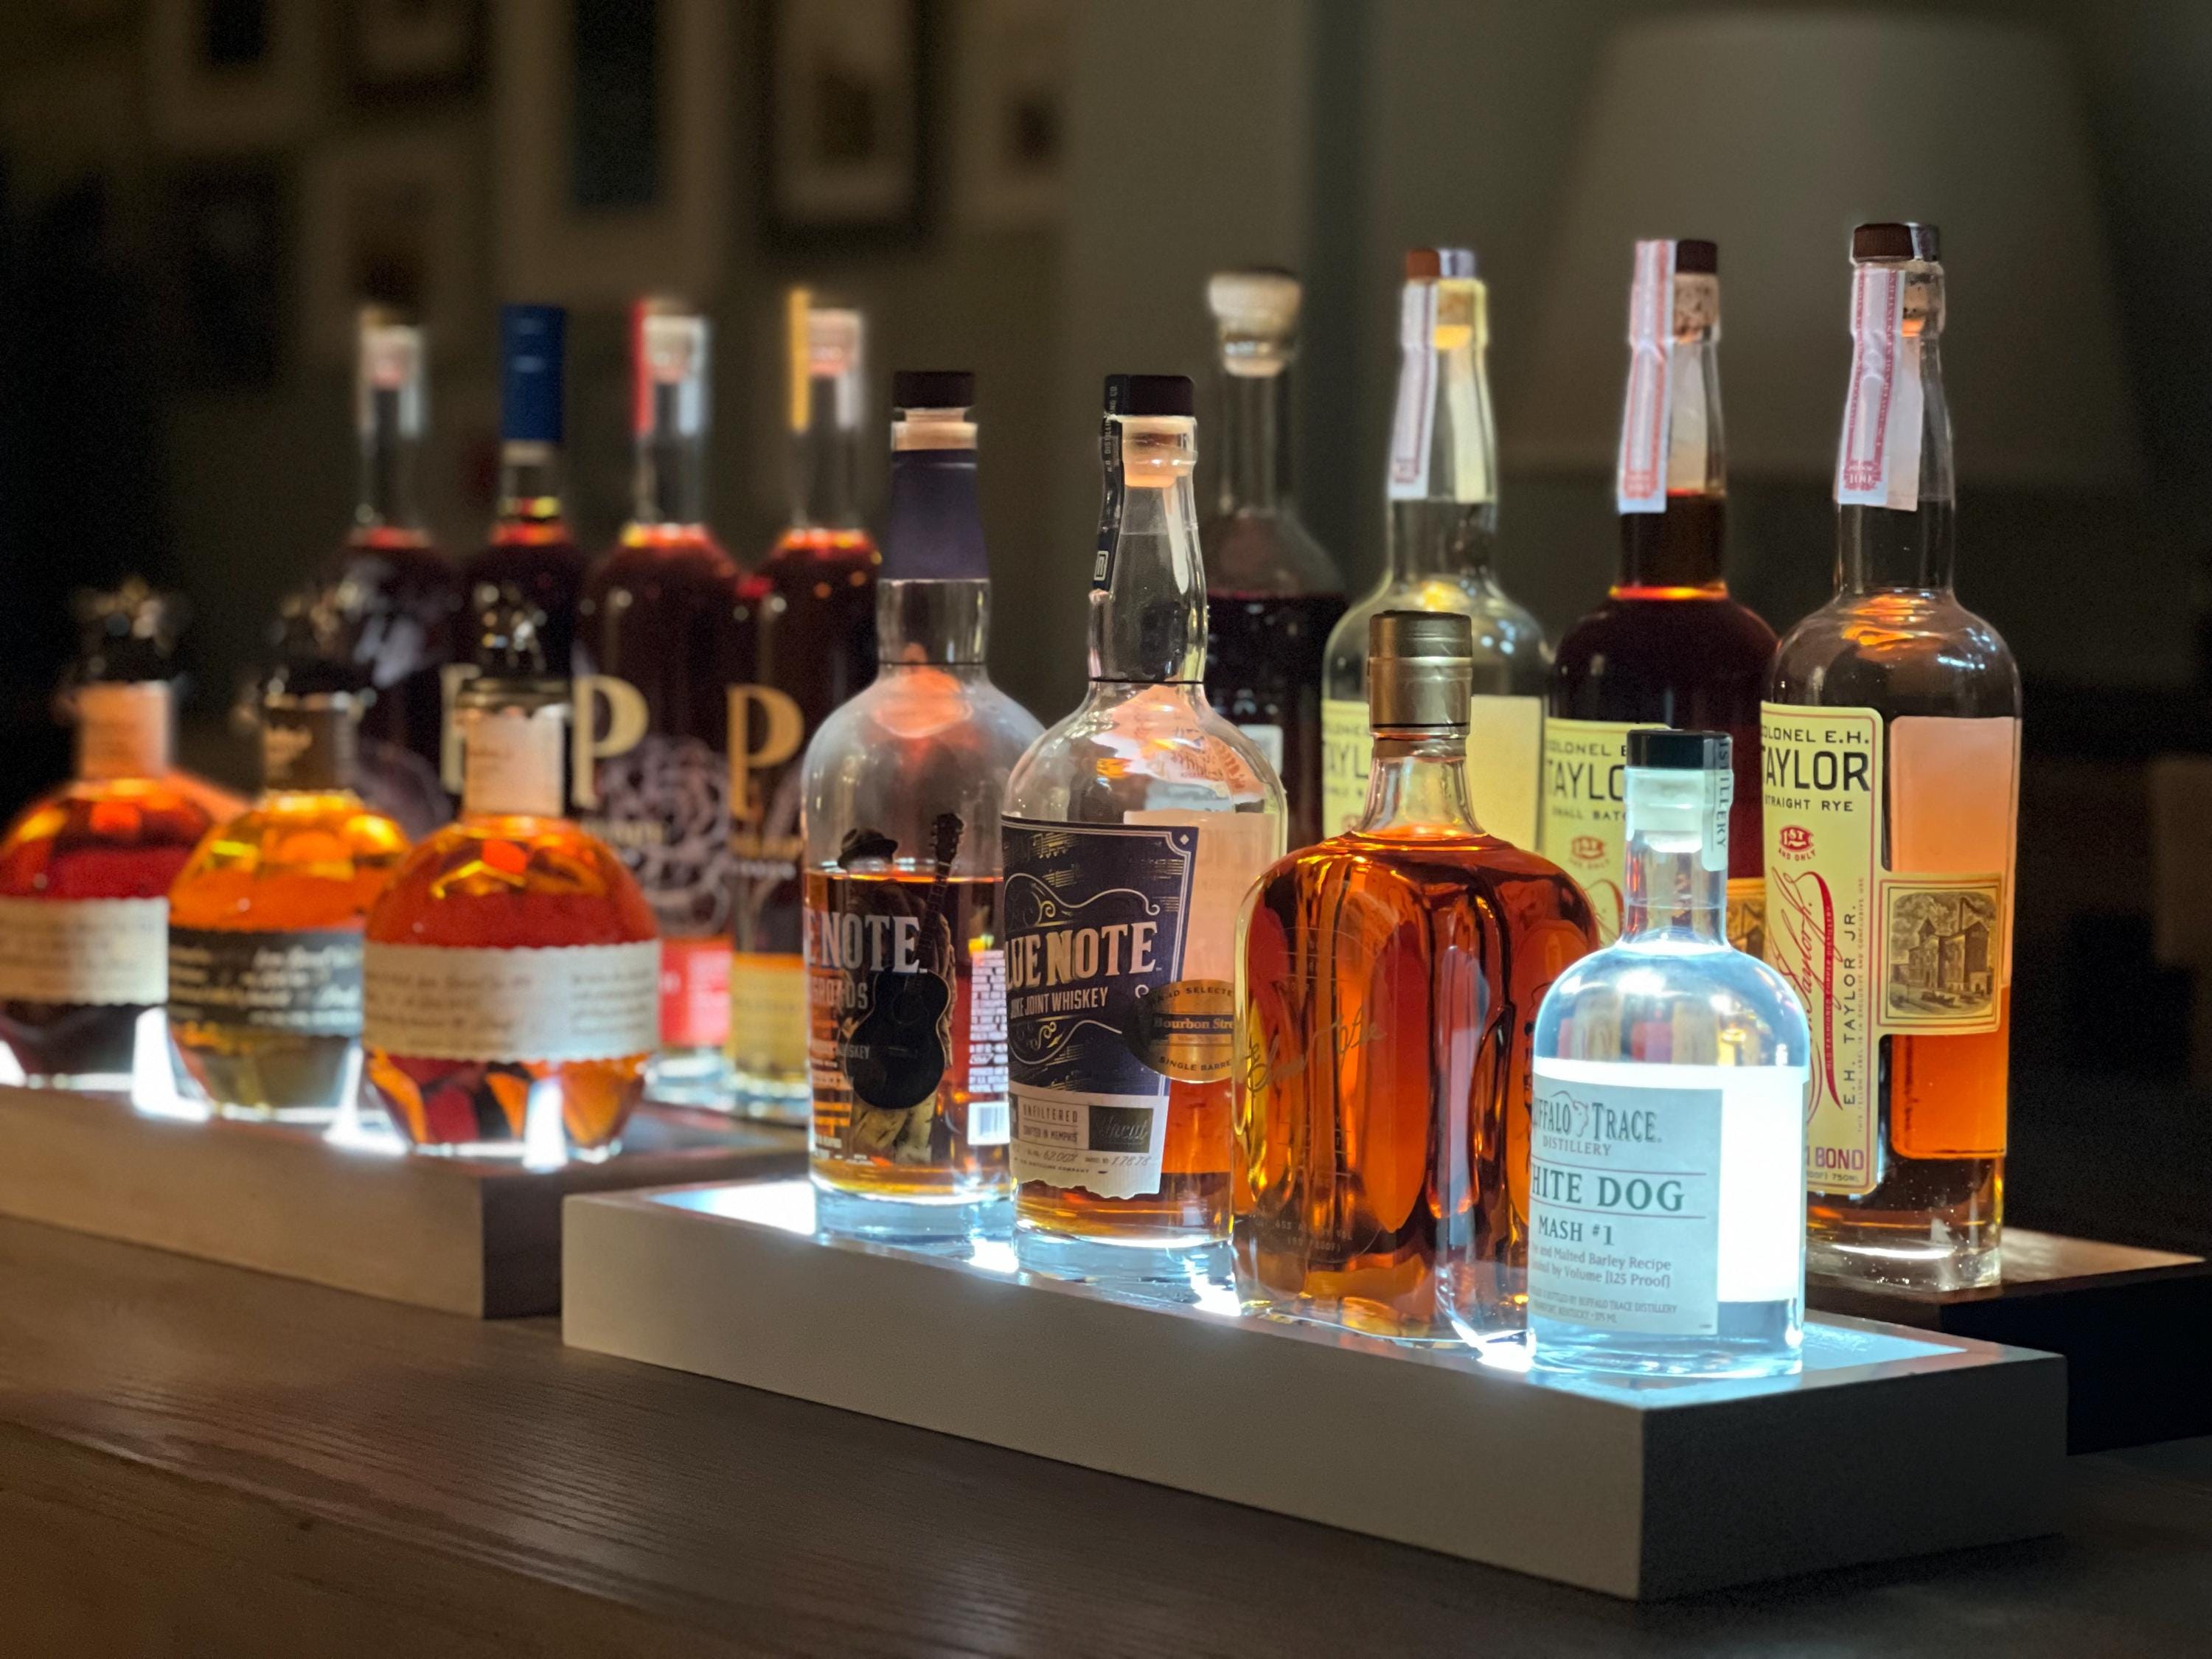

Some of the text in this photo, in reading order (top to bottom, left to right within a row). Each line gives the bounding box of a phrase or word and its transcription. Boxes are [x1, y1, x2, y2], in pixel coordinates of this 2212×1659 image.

[1825, 730, 1870, 744] E.H.
[1764, 794, 1854, 812] STRAIGHT RYE
[1593, 810, 1627, 821] BAT
[1778, 847, 1817, 862] AND ONLY
[820, 912, 920, 974] NOTE
[1004, 921, 1158, 991] LUE NOTE
[1026, 993, 1050, 1015] JOINT
[1051, 986, 1108, 1012] WHISKEY
[1186, 986, 1234, 996] SELECTE
[1843, 905, 1856, 1105] E.H. TAYLOR JR.
[1153, 1018, 1234, 1029] Bourbon Stre
[1159, 1056, 1231, 1071] SINGLE BARRE
[1023, 1104, 1078, 1123] UNFILTERED
[1531, 1097, 1572, 1135] UFFALO
[1542, 1135, 1612, 1157] DISTILLERY
[1815, 1147, 1865, 1171] BOND
[1531, 1163, 1685, 1212] HITE DOG
[1538, 1214, 1615, 1246] MASH #1
[1553, 1246, 1586, 1264] Malted
[1588, 1252, 1626, 1270] Barley
[1629, 1256, 1672, 1272] Recipe
[1564, 1267, 1603, 1283] Volume
[1609, 1301, 1635, 1312] TRACE
[1635, 1302, 1677, 1315] DISTILLERY
